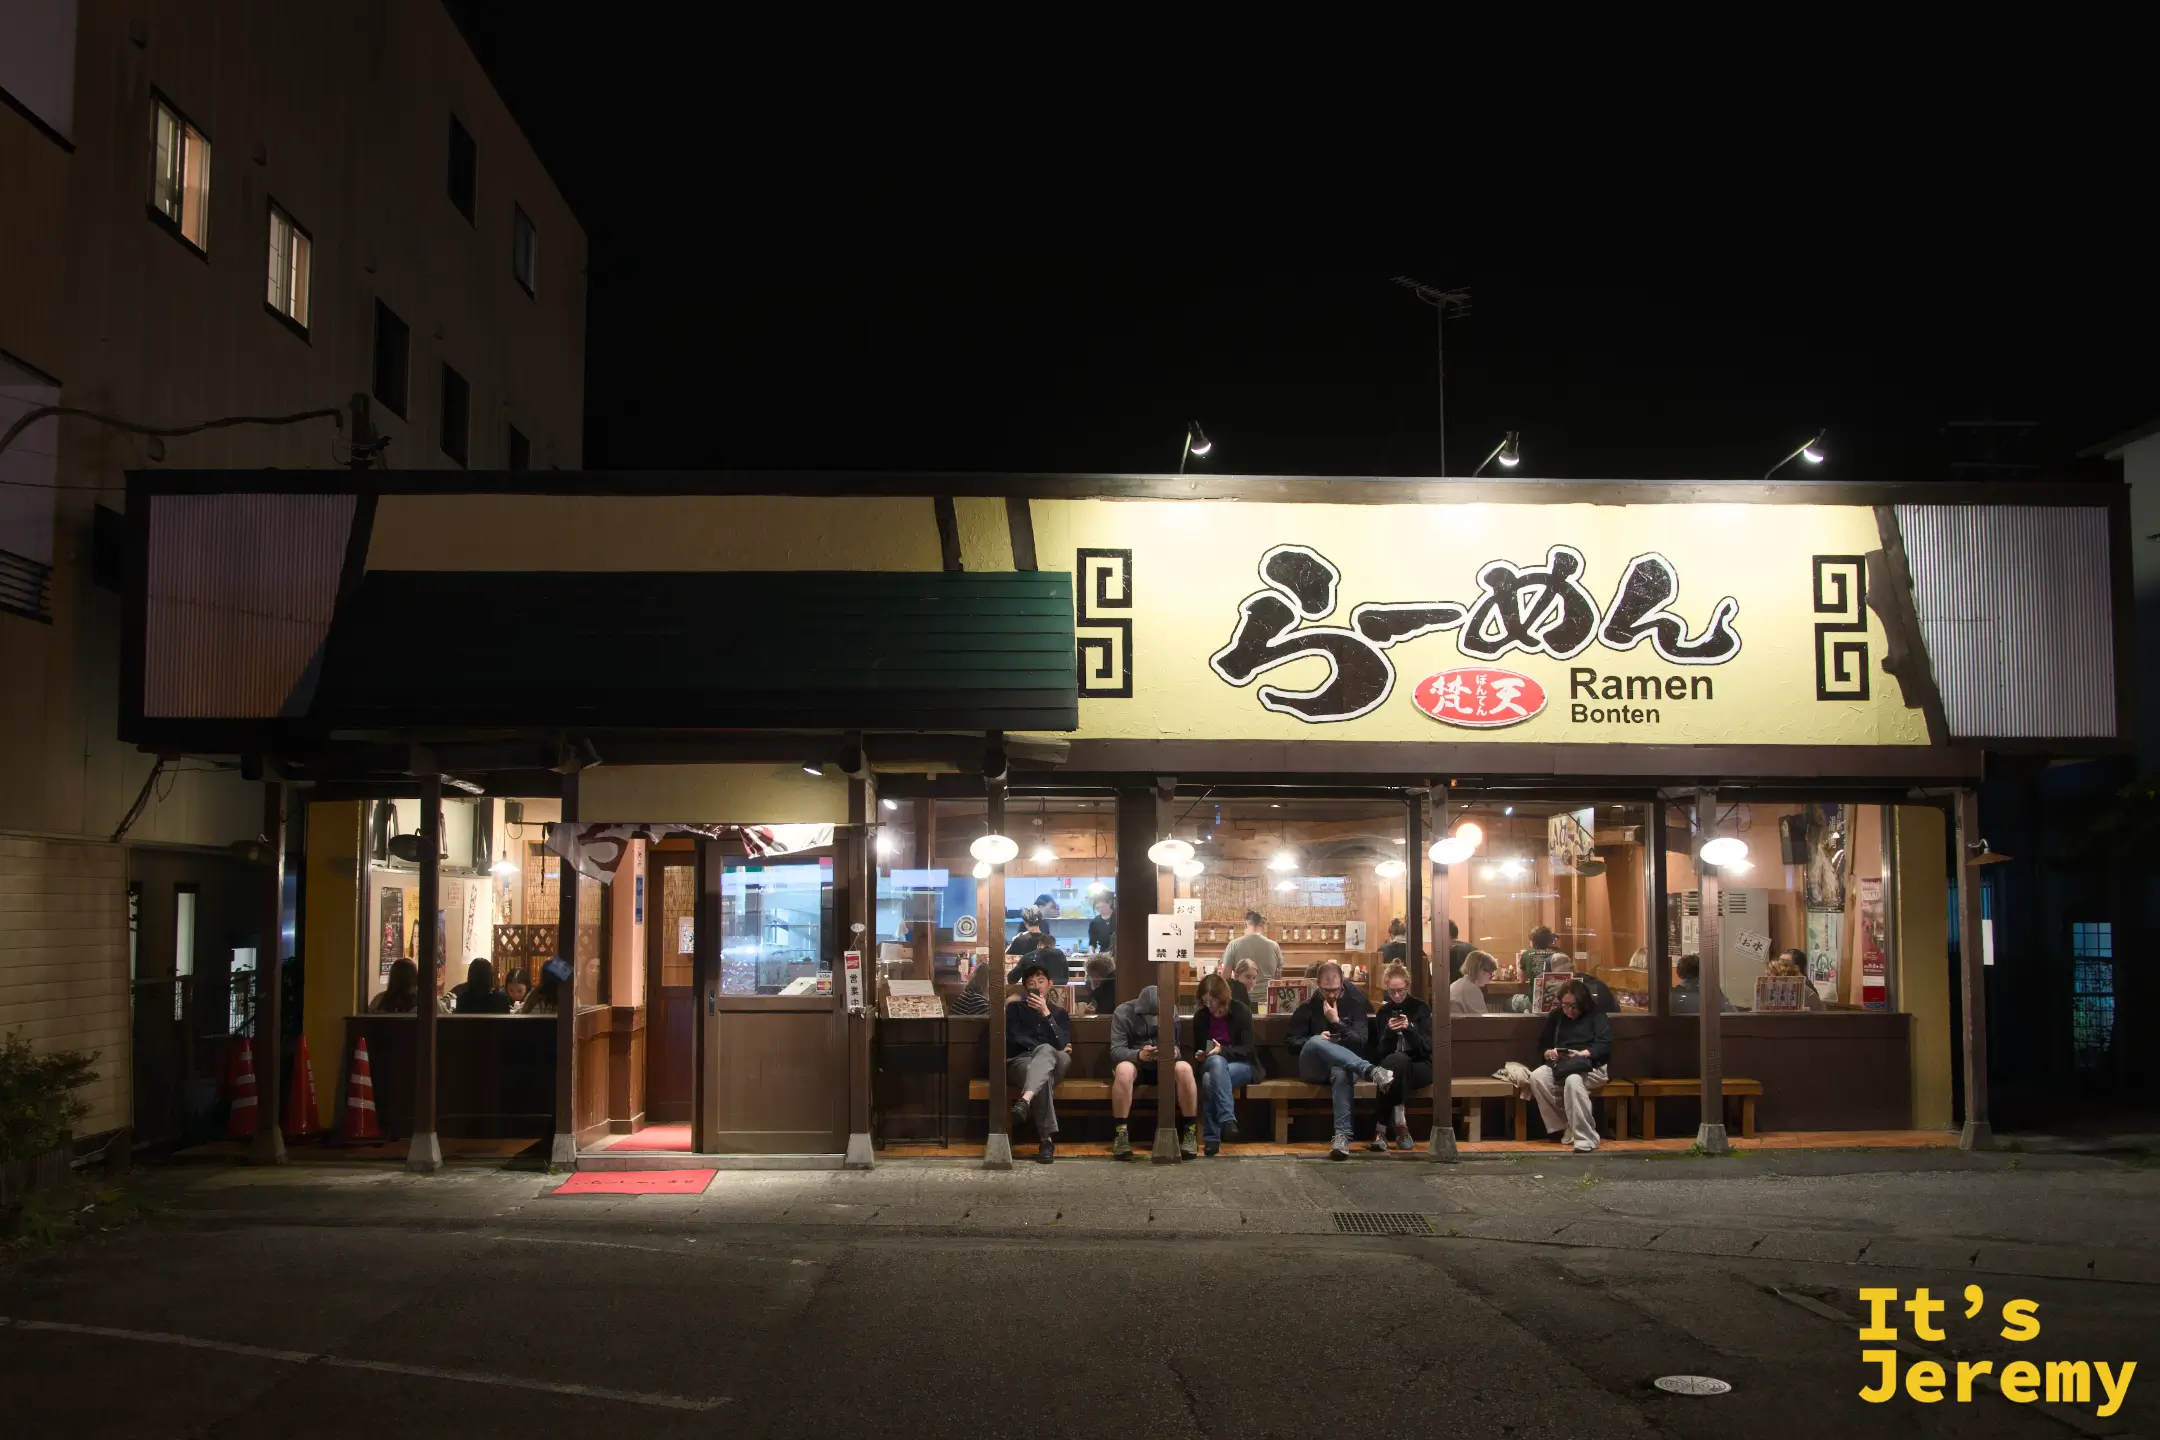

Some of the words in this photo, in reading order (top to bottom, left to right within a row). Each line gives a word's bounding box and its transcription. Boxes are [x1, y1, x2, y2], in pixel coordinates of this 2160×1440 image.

[1210, 544, 1742, 723] らーめん
[1429, 675, 1528, 716] 梵天
[1476, 674, 1488, 716] ぼんてん
[1570, 667, 1714, 701] Ramen
[1571, 703, 1660, 724] Bonten
[1177, 905, 1196, 914] お水
[1156, 948, 1187, 958] 禁煙
[1741, 938, 1763, 951] お水
[849, 974, 860, 1007] 営業中
